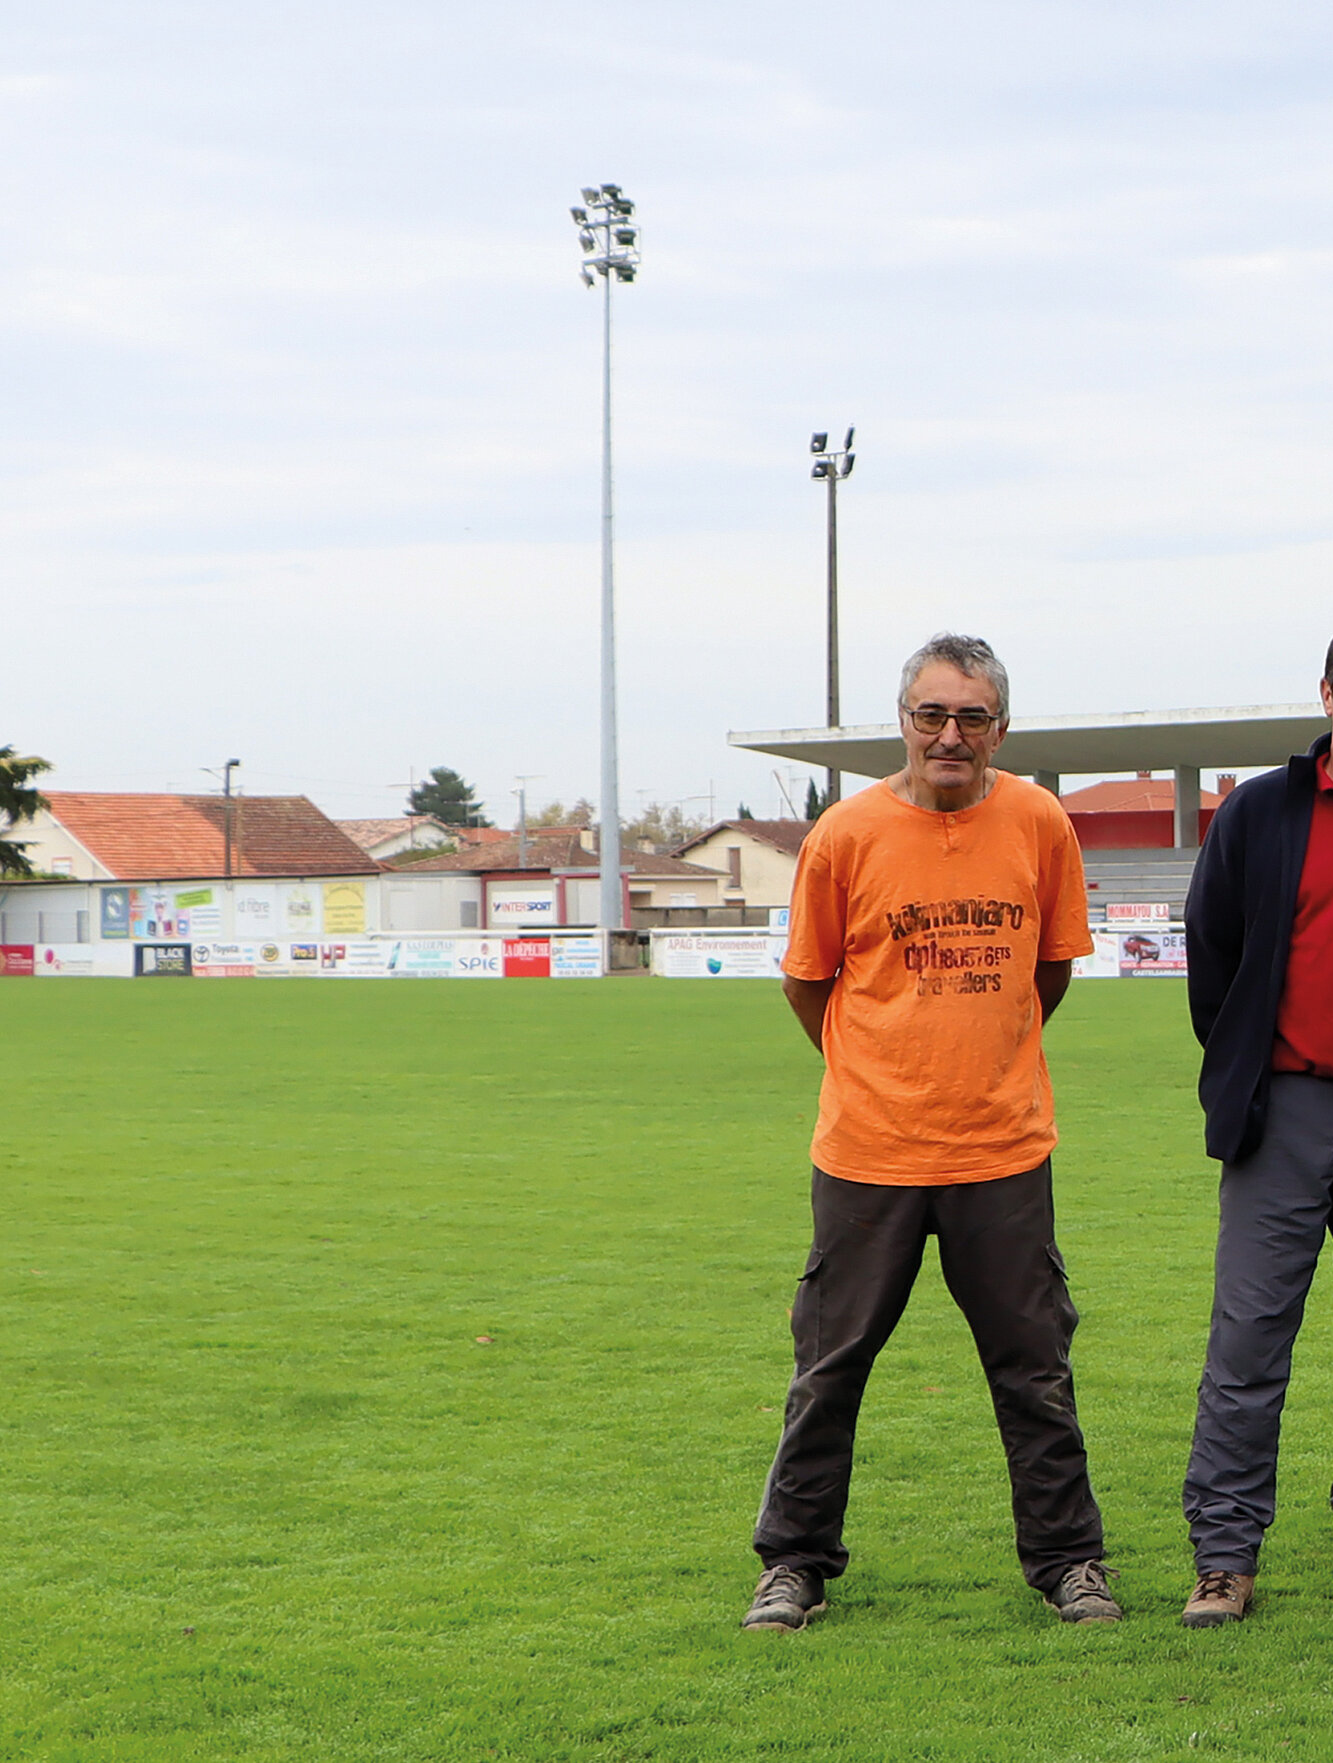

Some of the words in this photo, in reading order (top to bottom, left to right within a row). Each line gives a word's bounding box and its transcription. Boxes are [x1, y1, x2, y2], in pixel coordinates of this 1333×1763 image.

[696, 938, 768, 950] Environnement
[1163, 936, 1176, 947] DE
[156, 946, 185, 958] BLACK
[156, 959, 185, 970] STORE
[458, 957, 499, 971] SPIE
